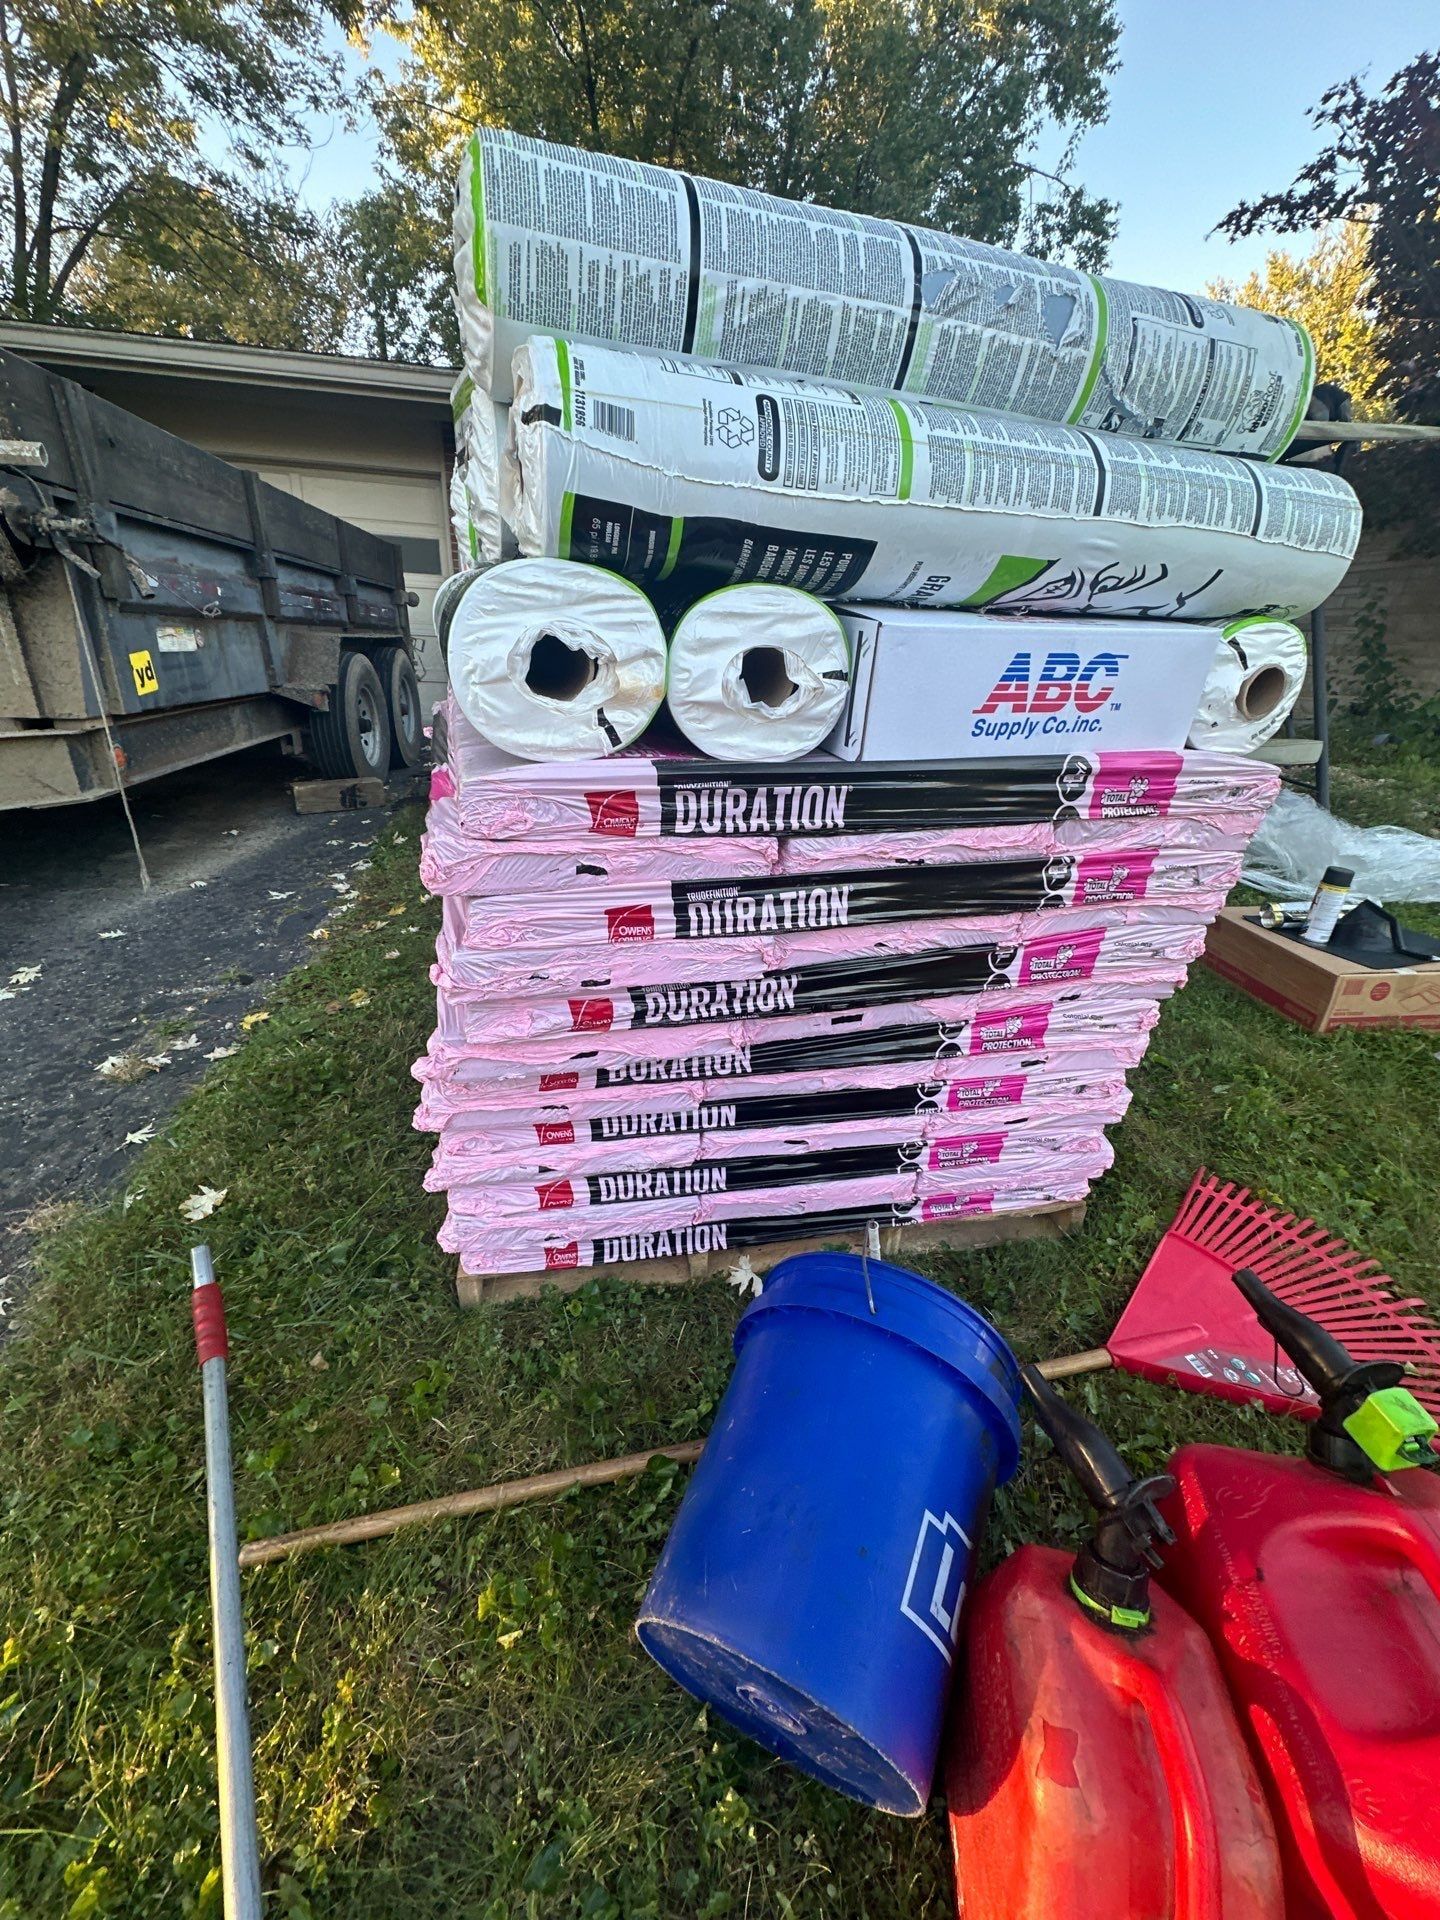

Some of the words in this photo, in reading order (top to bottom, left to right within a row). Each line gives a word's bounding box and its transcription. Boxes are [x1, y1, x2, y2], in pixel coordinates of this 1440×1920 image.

[575, 389, 585, 426] 1131856
[592, 518, 601, 529] 65
[756, 545, 779, 578] BARDEAUX
[801, 549, 817, 564] LES
[819, 551, 835, 566] LES
[834, 553, 852, 572] POUR
[136, 660, 154, 688] yd
[972, 653, 1130, 714] ABC
[1110, 703, 1122, 711] TM
[971, 716, 1040, 741] Supply
[1106, 794, 1126, 802] TOTAL
[674, 785, 848, 834] DURATION
[1101, 805, 1157, 819] PROTECTION
[1087, 882, 1107, 891] TOTAL
[686, 887, 739, 902] TRUDEFINITION
[618, 925, 653, 936] OWENS
[1033, 960, 1053, 969] TOTAL
[1030, 969, 1082, 982] PROTECTION
[644, 973, 799, 1024] DURATION
[984, 1030, 1005, 1039] TOTAL
[982, 1038, 1032, 1051] PROTECTION
[960, 1089, 980, 1098] TOTAL
[546, 1129, 573, 1139] OWENS
[942, 1151, 960, 1159] TOTAL
[934, 1204, 953, 1212] TOTAL
[603, 1223, 727, 1264] DURATION
